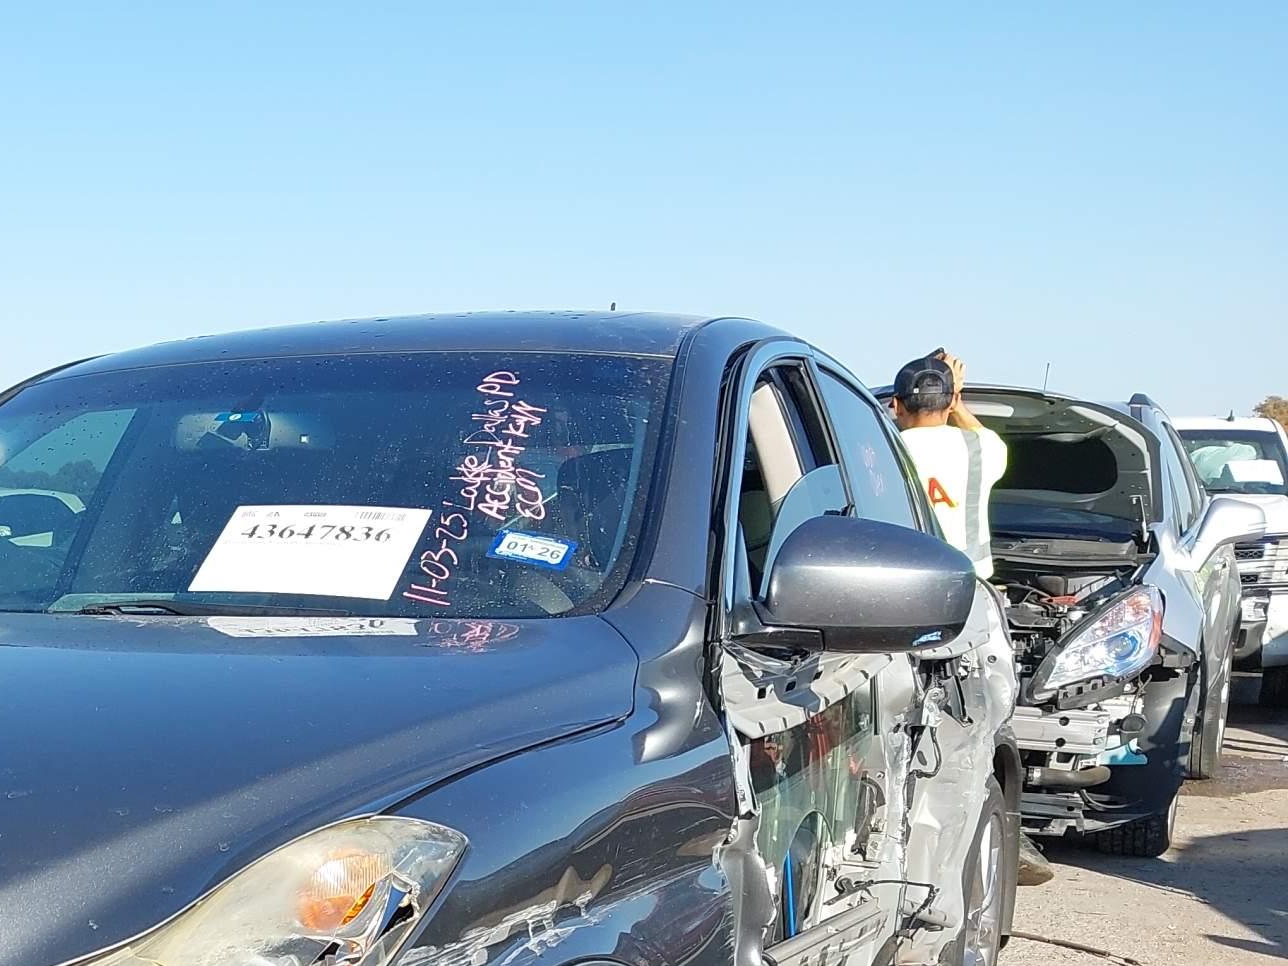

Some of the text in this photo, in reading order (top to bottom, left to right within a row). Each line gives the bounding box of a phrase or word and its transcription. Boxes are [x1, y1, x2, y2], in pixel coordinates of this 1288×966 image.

[402, 512, 468, 605] 11-03-25
[477, 371, 520, 396] PD
[241, 523, 393, 542] 43647836
[537, 547, 562, 560] 26
